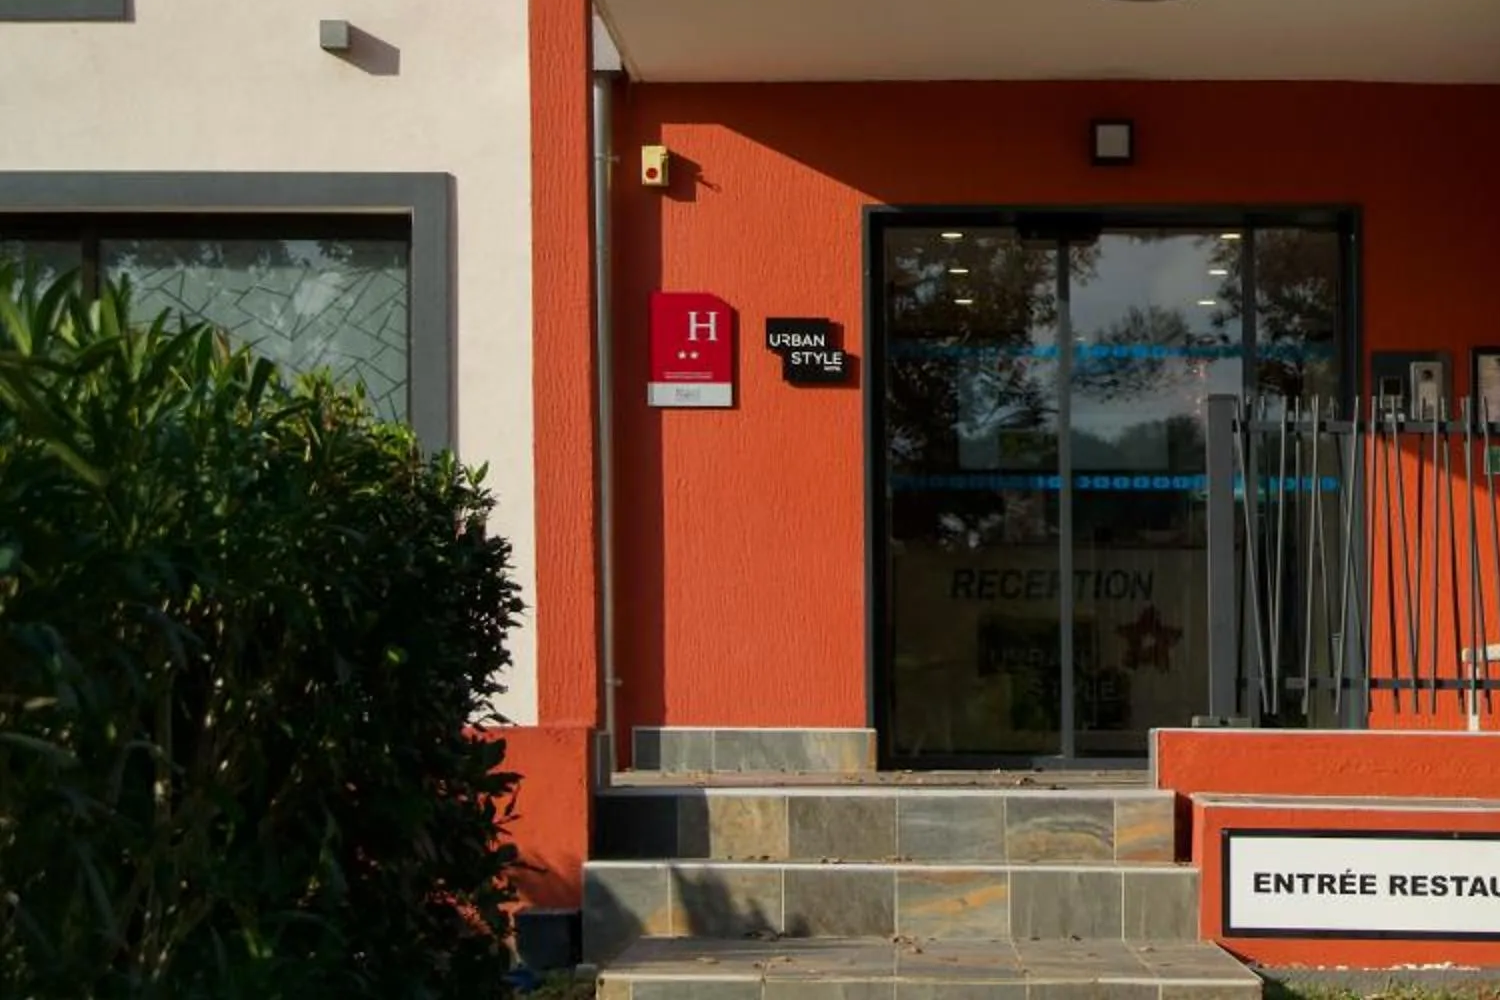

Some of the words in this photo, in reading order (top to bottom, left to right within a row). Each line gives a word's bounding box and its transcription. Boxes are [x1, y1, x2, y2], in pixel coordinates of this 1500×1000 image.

[687, 311, 718, 342] H
[769, 333, 826, 347] URBAN
[791, 351, 843, 365] STYLE
[1252, 868, 1378, 896] ENTRÉE
